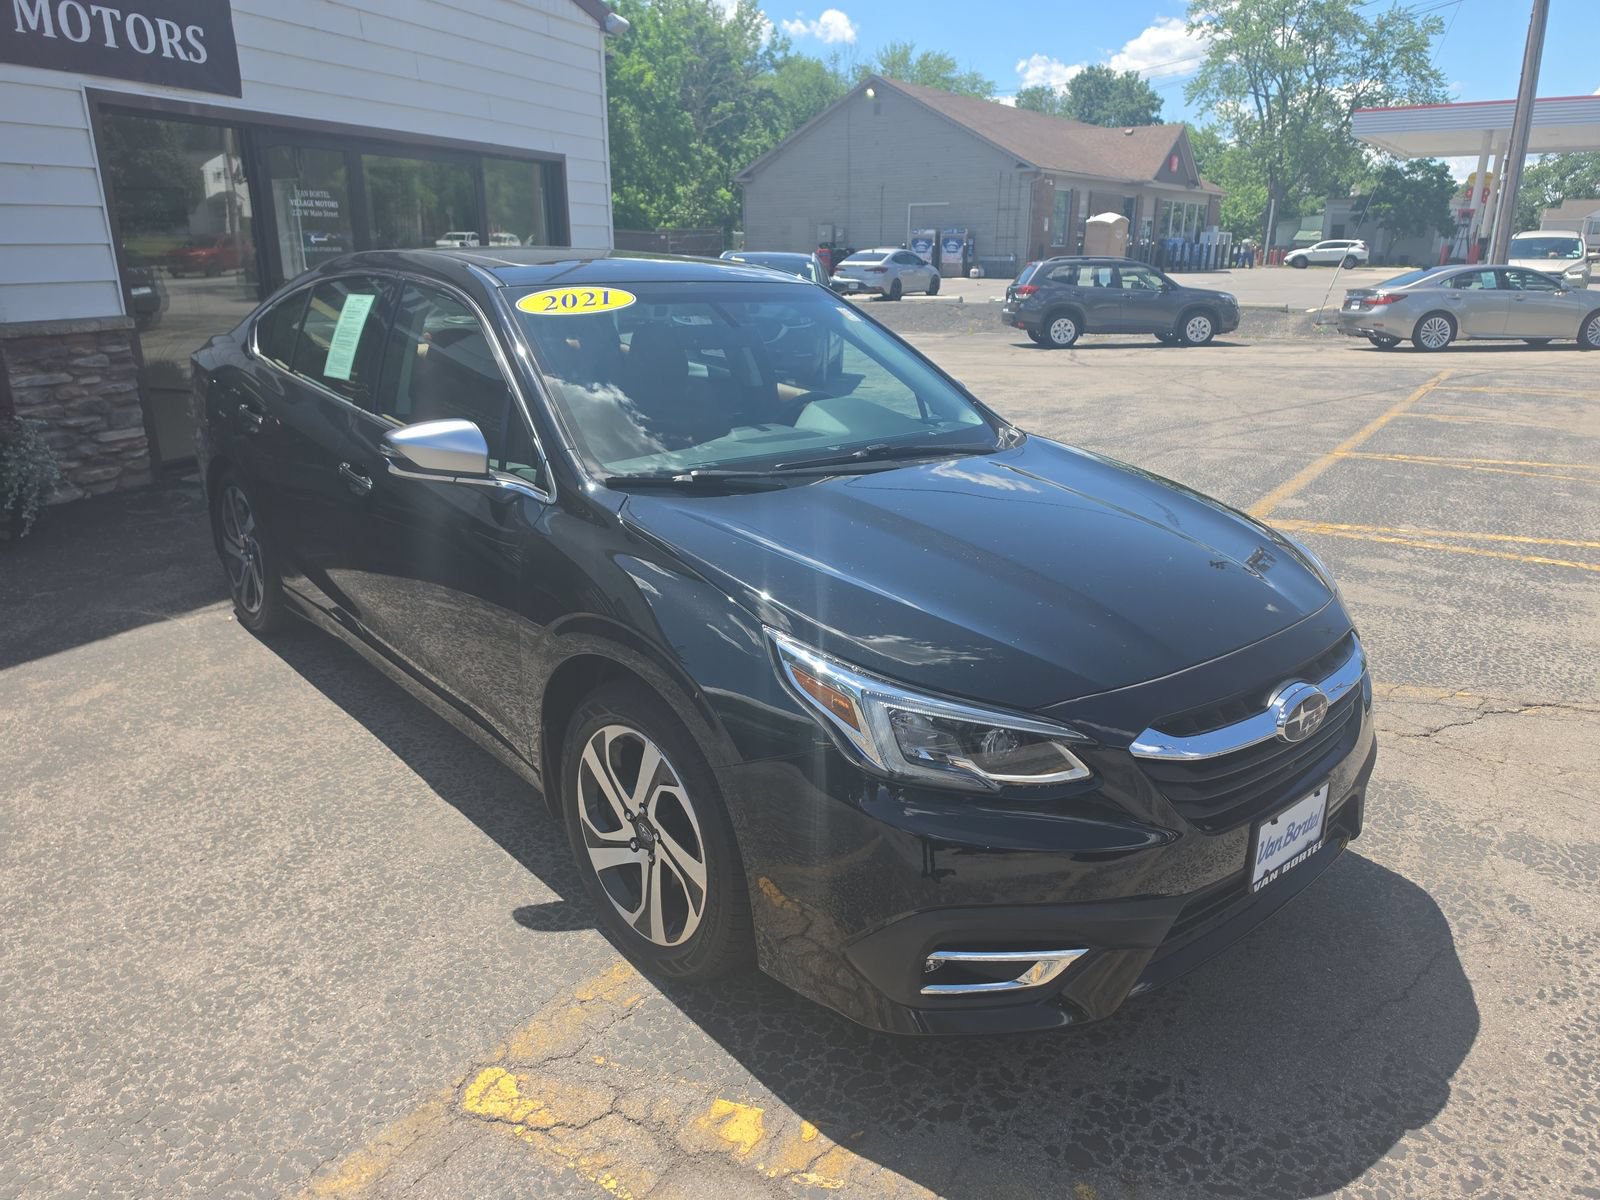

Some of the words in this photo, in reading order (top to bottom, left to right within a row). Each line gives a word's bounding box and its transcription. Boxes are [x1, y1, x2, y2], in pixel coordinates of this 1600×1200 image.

[13, 0, 208, 64] MOTORS
[289, 199, 314, 207] VILLAGE
[315, 200, 339, 209] MOTORS
[542, 290, 611, 312] 2021
[1253, 869, 1279, 893] VAN
[1282, 840, 1323, 874] BORTEL
